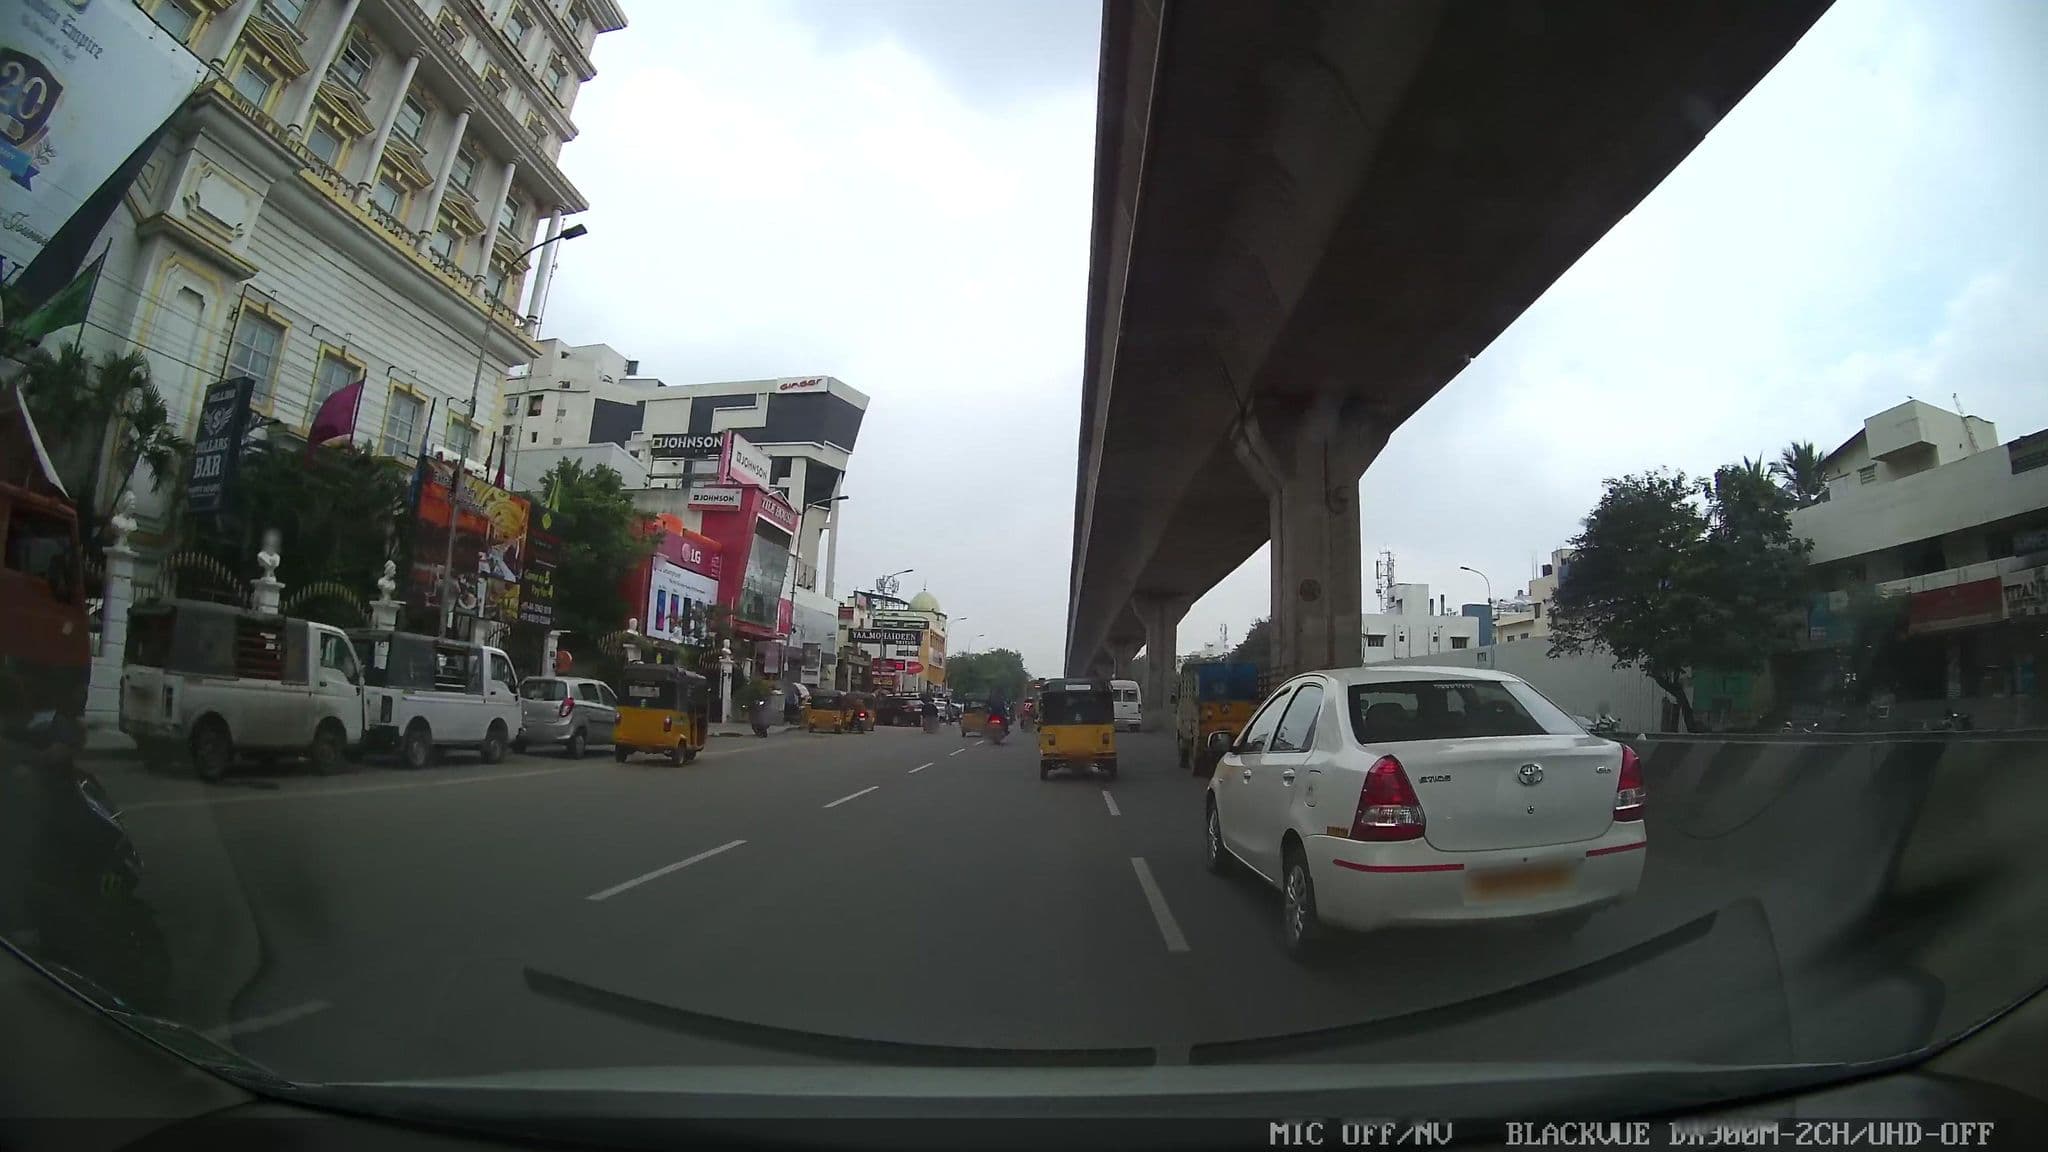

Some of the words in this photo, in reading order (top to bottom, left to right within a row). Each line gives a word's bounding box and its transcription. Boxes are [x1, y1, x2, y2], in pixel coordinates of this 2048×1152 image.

[661, 436, 724, 450] JOHNSON
[193, 455, 222, 480] BAR
[741, 456, 768, 480] JOHNSON
[699, 494, 735, 502] JOHNSON
[690, 548, 702, 565] LG
